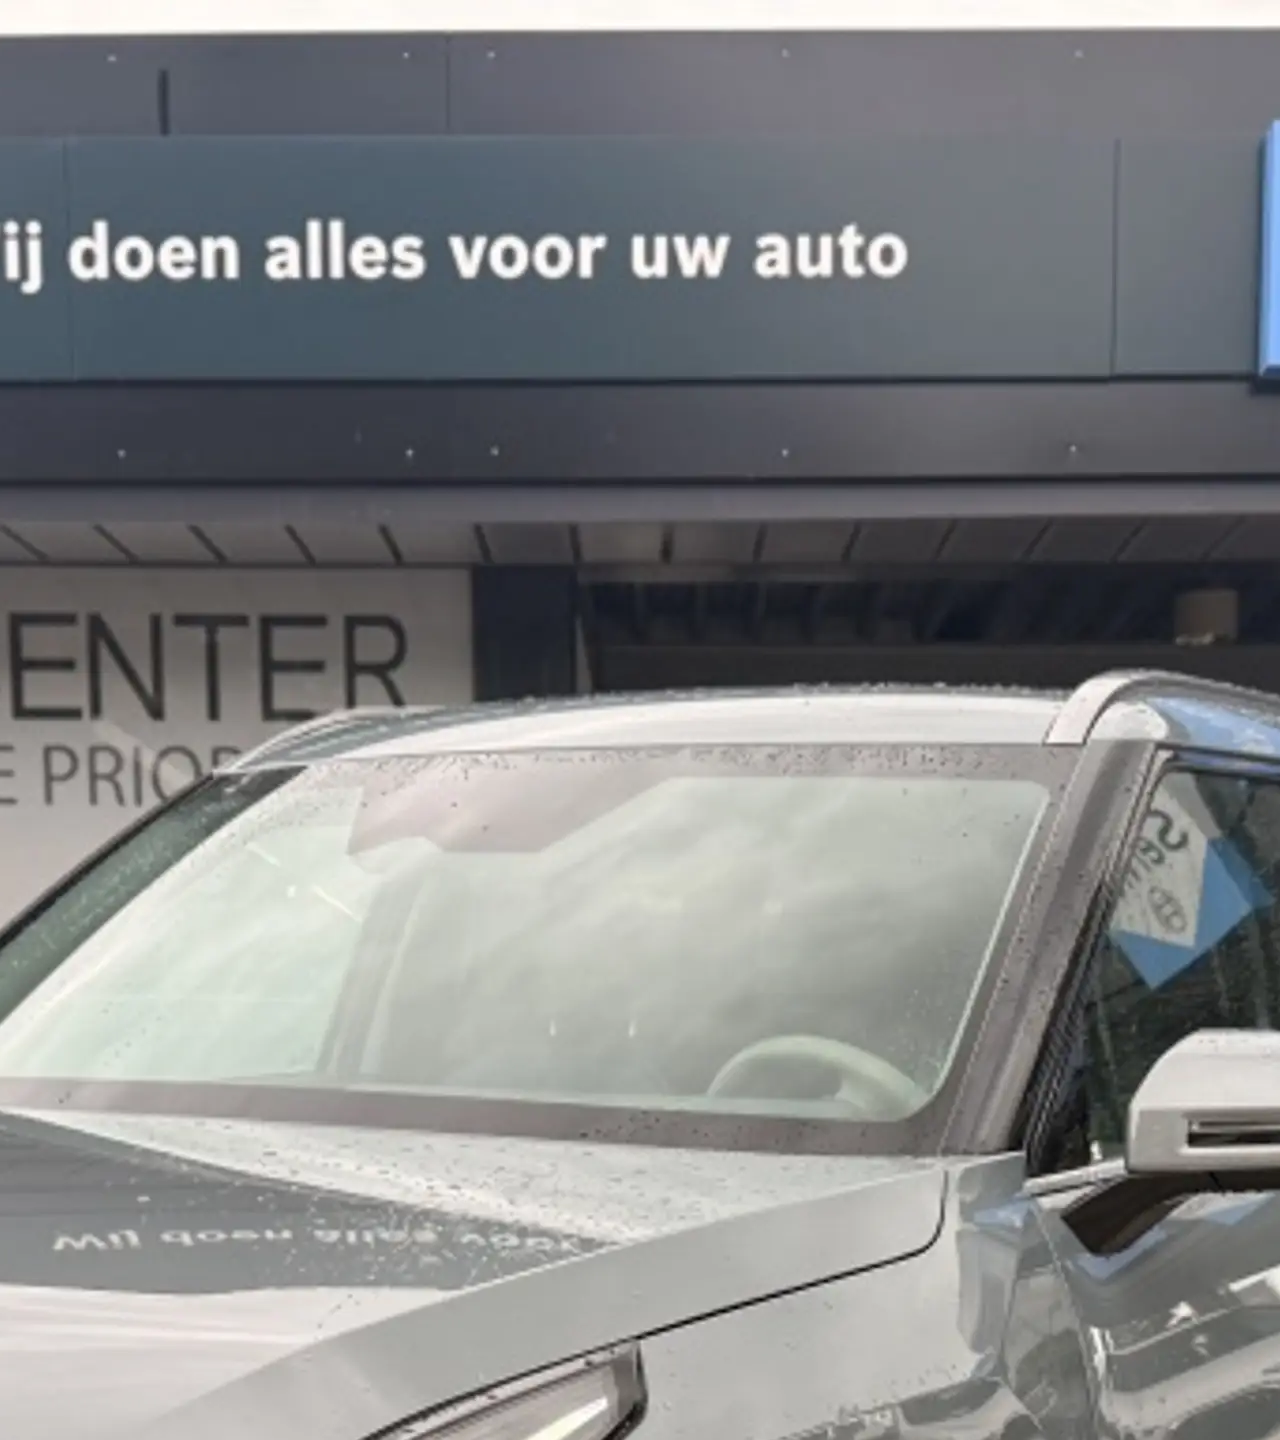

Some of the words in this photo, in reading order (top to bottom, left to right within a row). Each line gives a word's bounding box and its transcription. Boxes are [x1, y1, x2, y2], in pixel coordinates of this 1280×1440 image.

[68, 219, 240, 281] doen
[264, 219, 427, 281] alles
[448, 233, 608, 280] voor
[630, 233, 731, 280] uw
[753, 222, 908, 280] auto
[42, 744, 242, 807] PRIO
